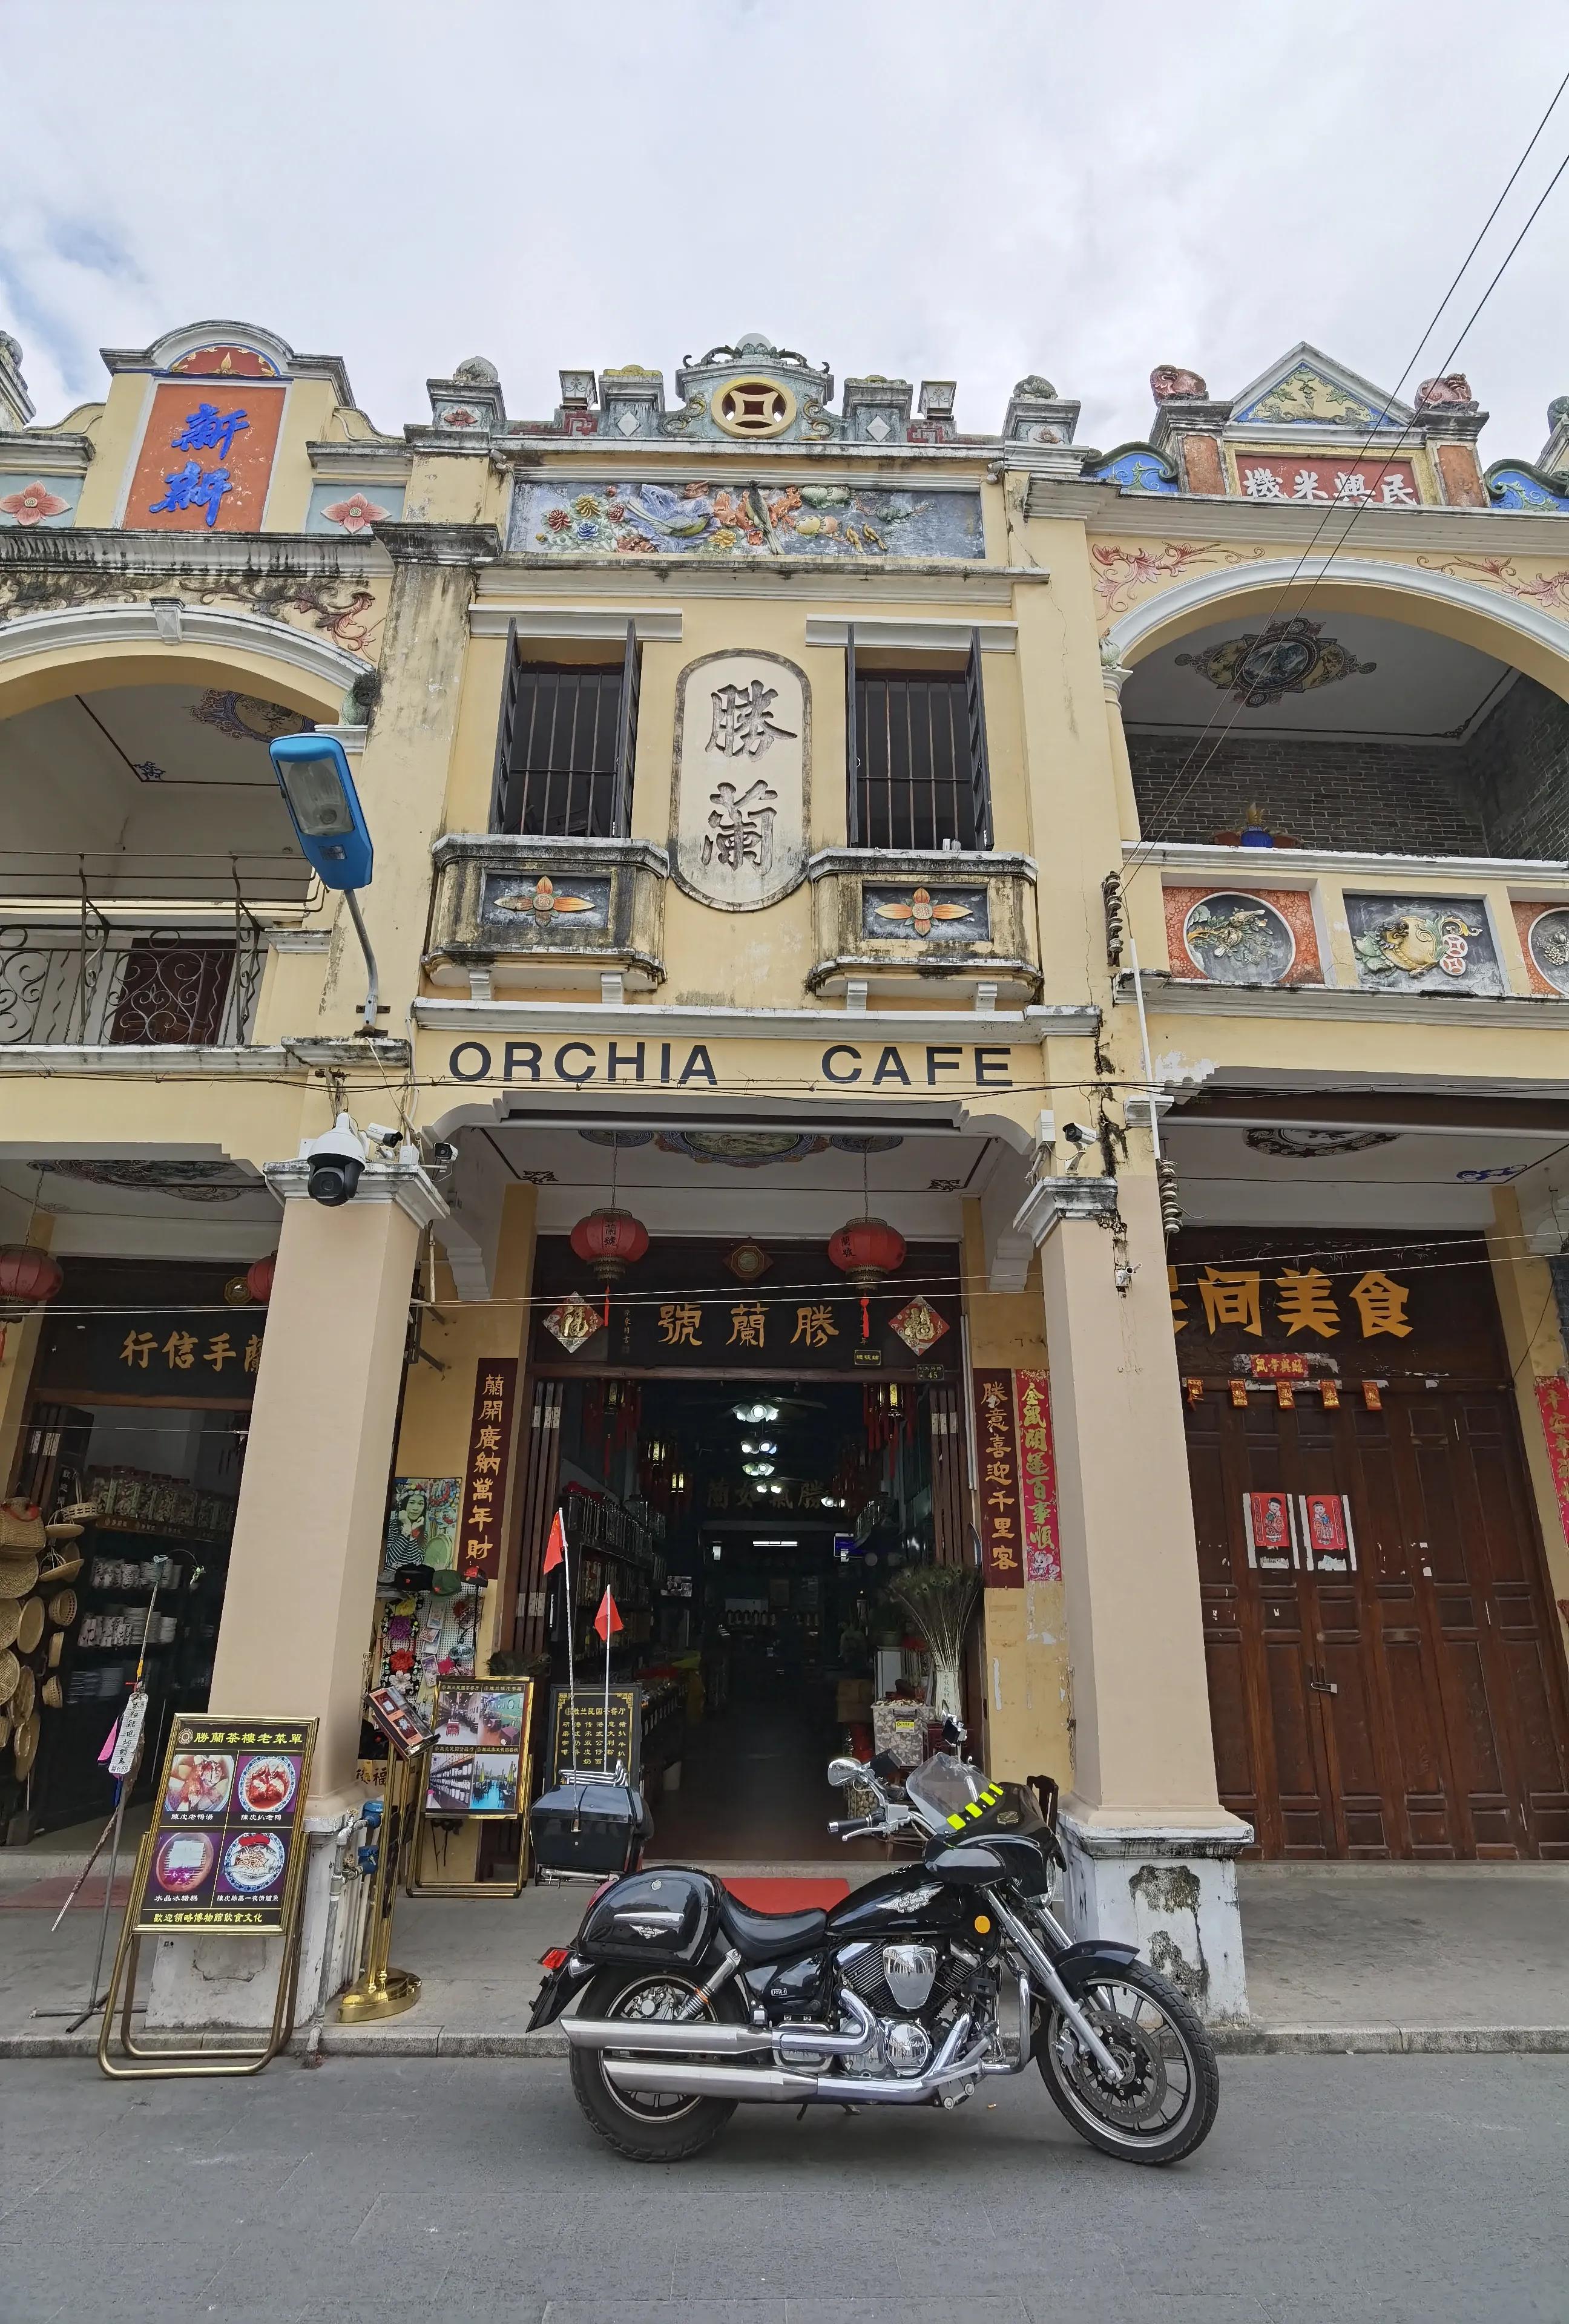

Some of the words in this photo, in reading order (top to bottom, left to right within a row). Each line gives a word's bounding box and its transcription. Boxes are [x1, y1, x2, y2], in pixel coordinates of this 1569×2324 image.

[449, 1041, 719, 1086] ORCHIA
[821, 1045, 1013, 1087] CAFE
[657, 1302, 840, 1347] 勝蘭號
[465, 1373, 504, 1560] 蘭開廣納萬年財
[194, 1732, 303, 1744] 勝蘭茶樓老菜單
